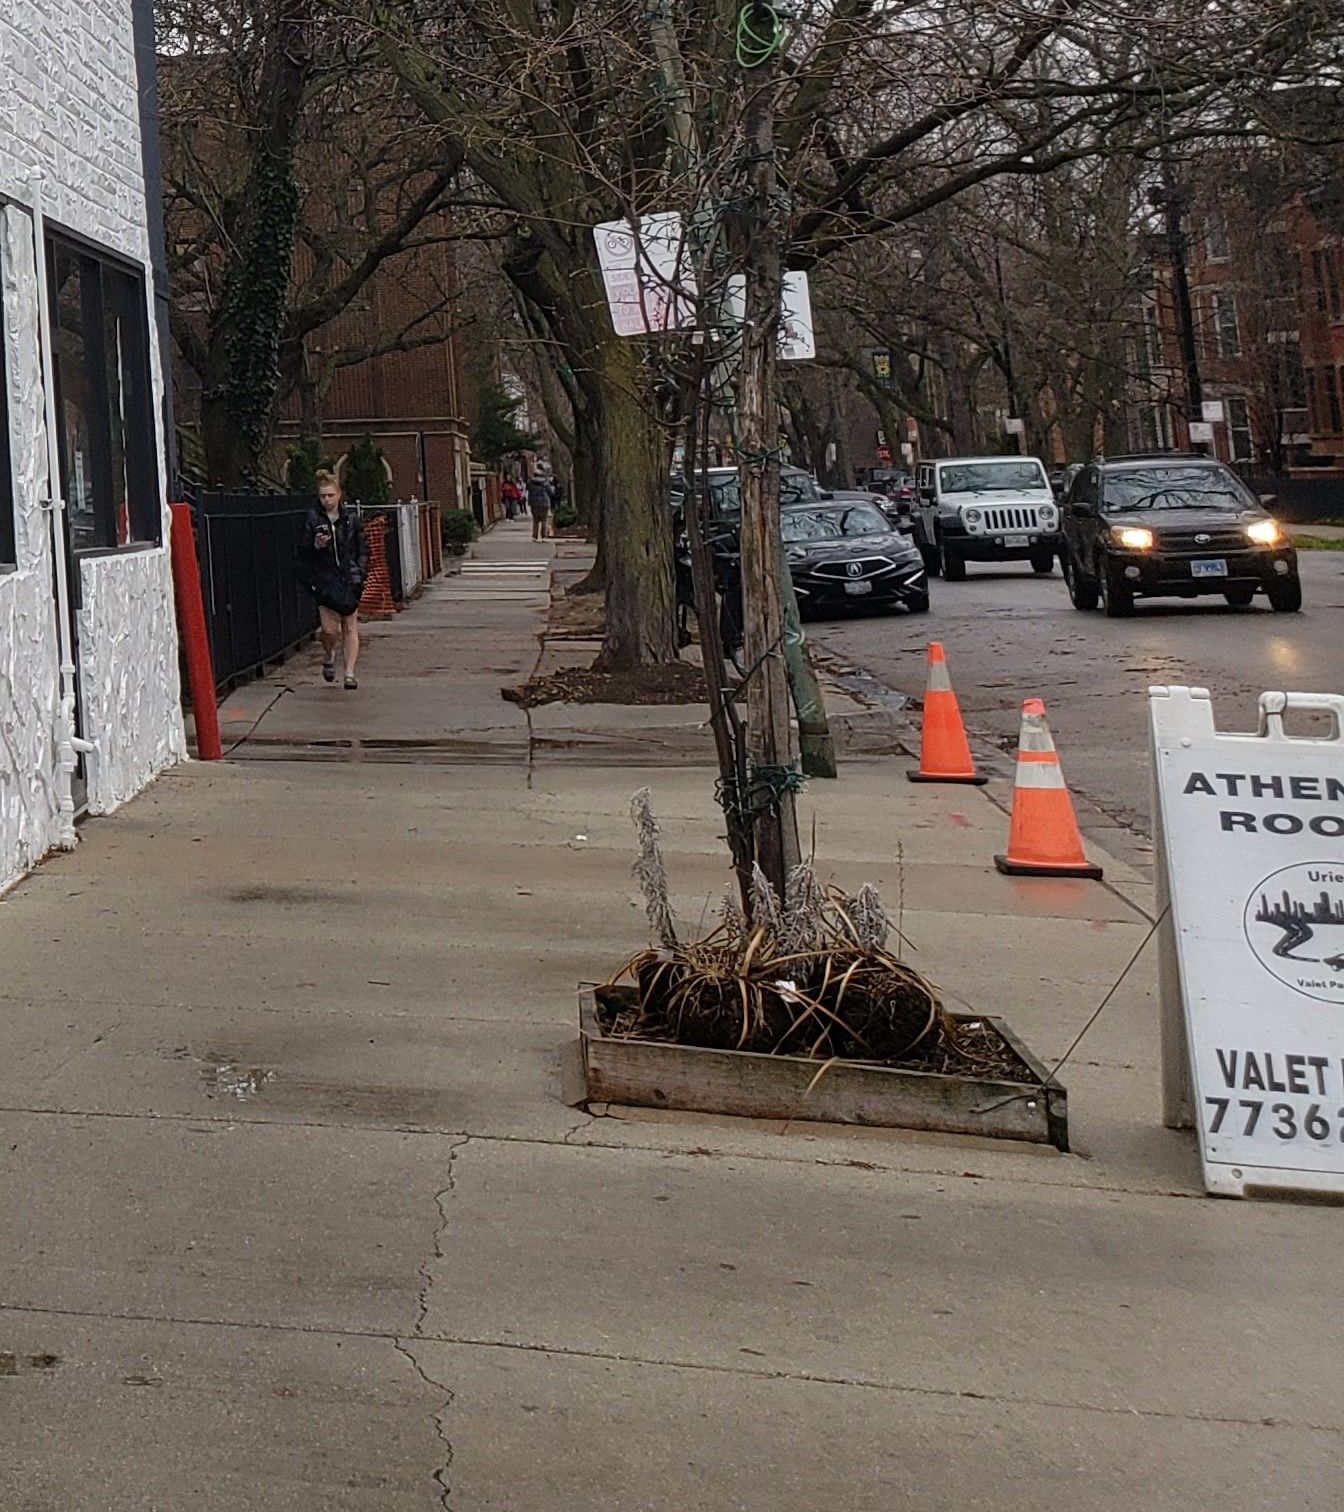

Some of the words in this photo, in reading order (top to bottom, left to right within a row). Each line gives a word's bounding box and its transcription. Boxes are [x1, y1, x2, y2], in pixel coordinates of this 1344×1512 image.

[1297, 978, 1327, 989] Valet
[1215, 1048, 1329, 1096] VALET
[1205, 1096, 1344, 1144] 7736
